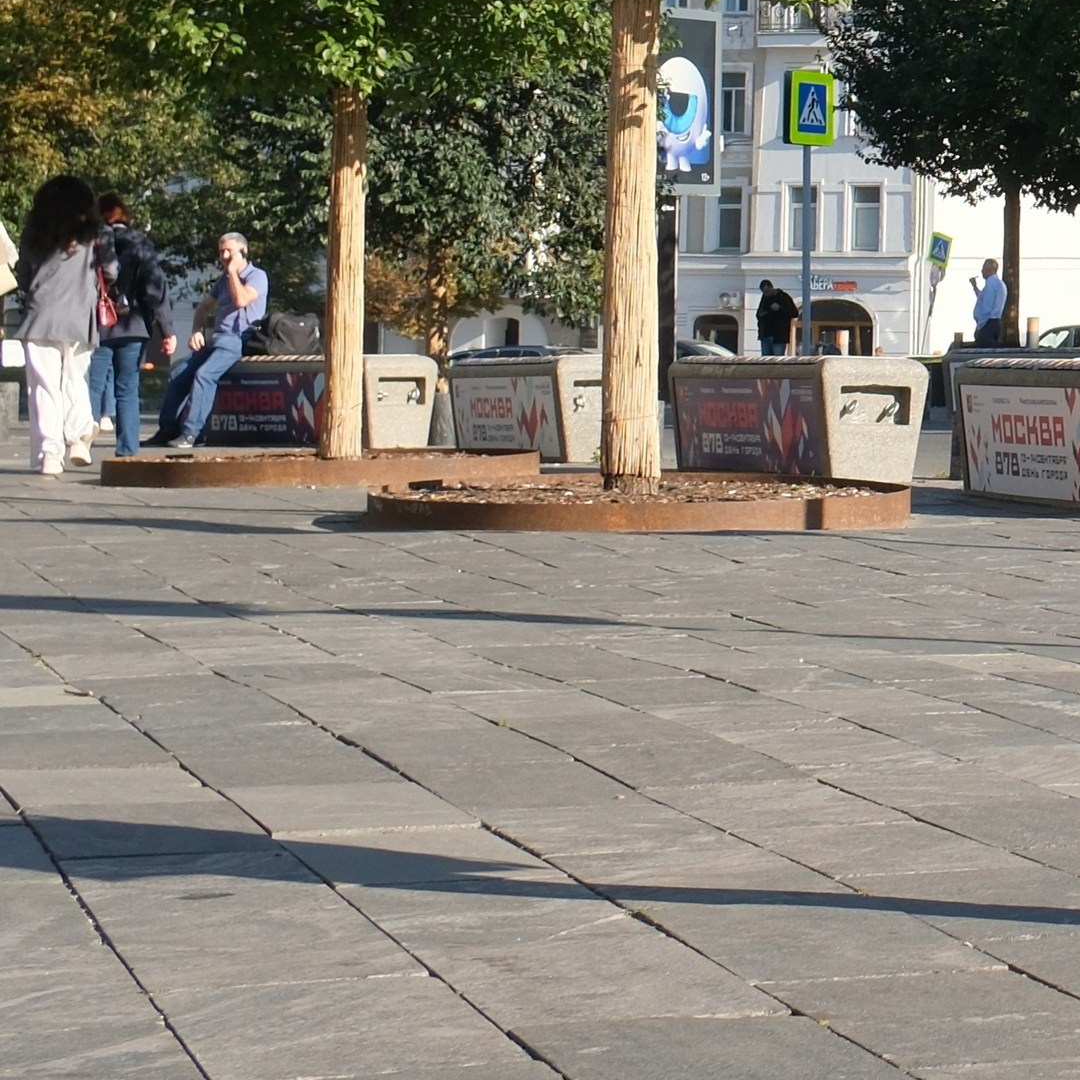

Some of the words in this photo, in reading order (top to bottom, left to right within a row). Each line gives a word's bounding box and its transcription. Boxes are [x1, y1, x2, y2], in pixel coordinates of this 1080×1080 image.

[217, 391, 285, 410] ОСКВА
[470, 397, 513, 418] МОСКВА
[991, 413, 1066, 447] МОСКВА
[995, 451, 1020, 477] 878
